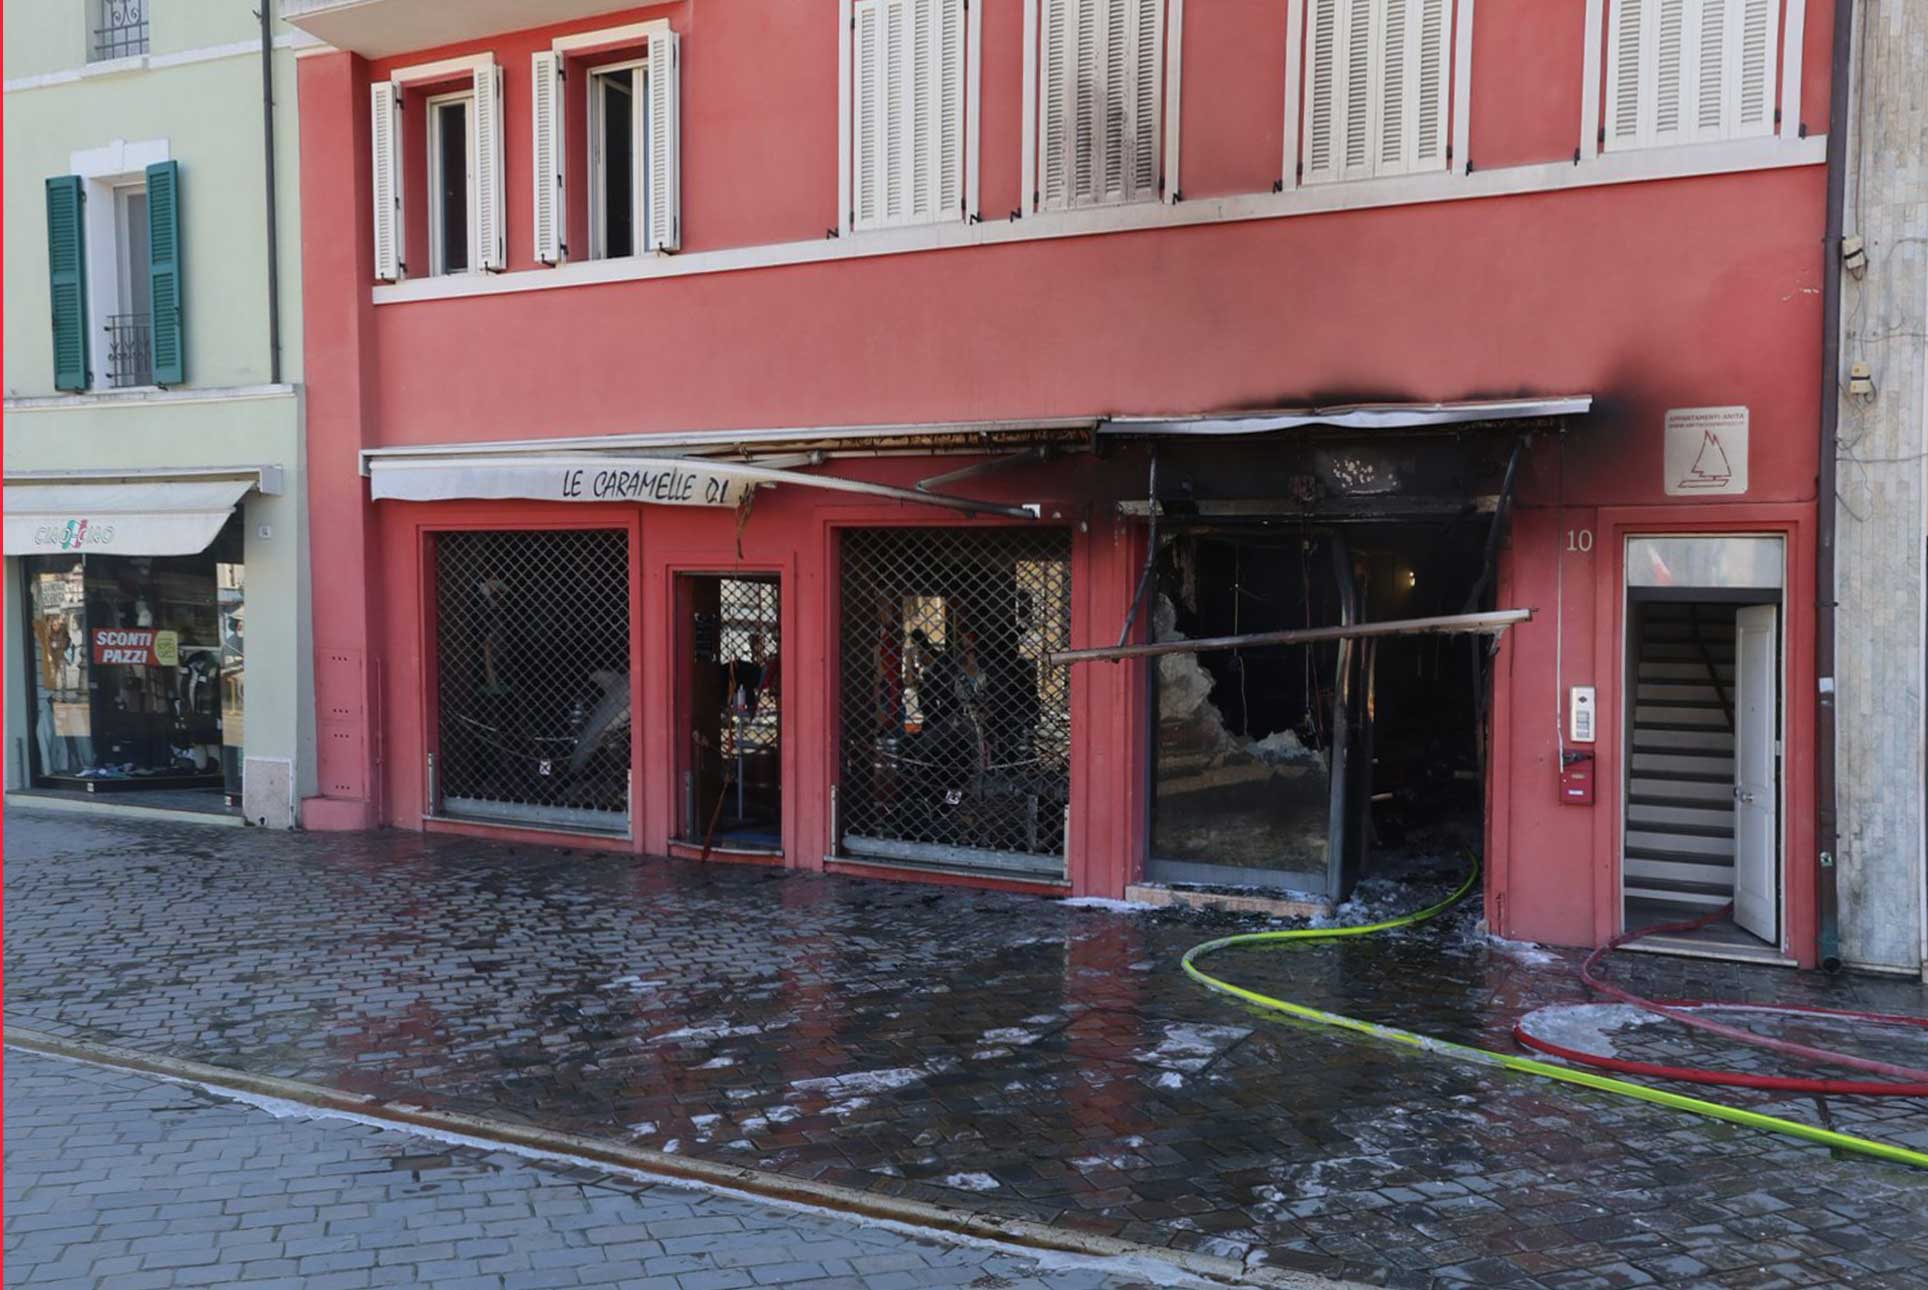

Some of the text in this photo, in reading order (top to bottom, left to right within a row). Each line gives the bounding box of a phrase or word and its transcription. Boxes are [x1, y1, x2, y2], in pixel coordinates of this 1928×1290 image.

[562, 470, 583, 497] LE
[593, 468, 696, 502] CARAMELLE
[706, 476, 728, 504] DI
[1567, 529, 1592, 552] 10
[96, 631, 152, 646] SCONTI
[102, 649, 148, 664] PAZZI
